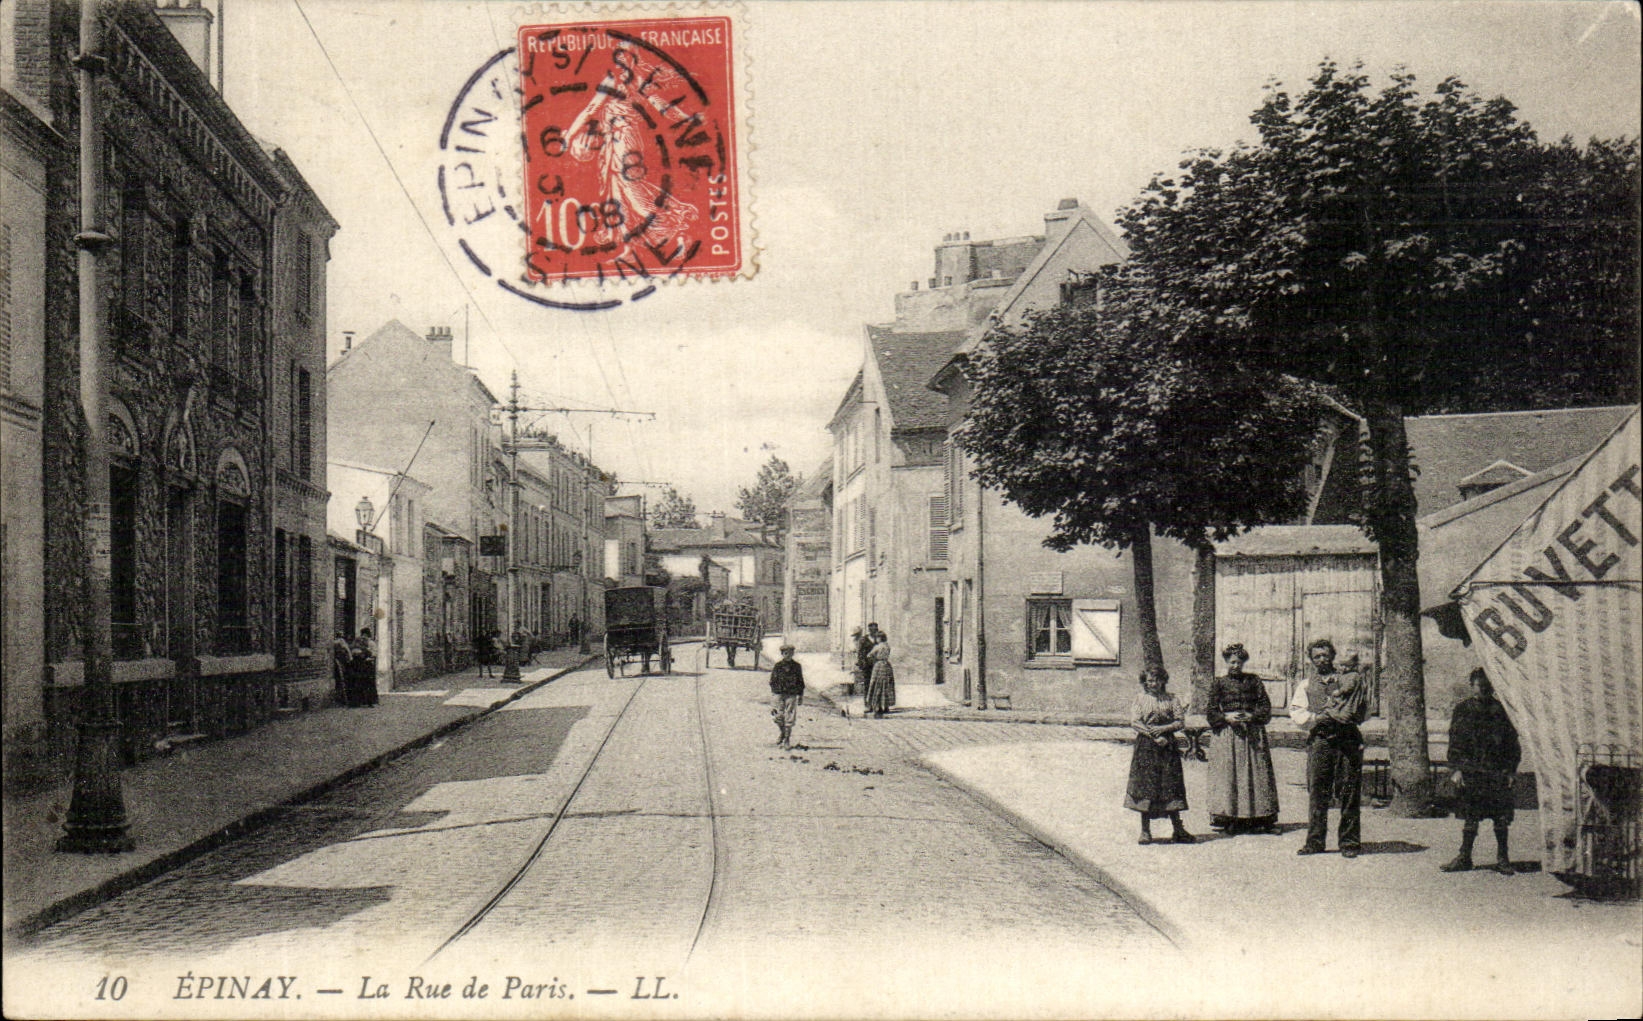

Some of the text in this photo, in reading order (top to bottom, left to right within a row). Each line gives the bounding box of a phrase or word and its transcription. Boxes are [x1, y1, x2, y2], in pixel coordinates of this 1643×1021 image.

[640, 27, 722, 48] FRANÇAISE
[536, 197, 588, 252] 10
[708, 174, 730, 255] POSTES
[1473, 463, 1642, 660] BUVETT
